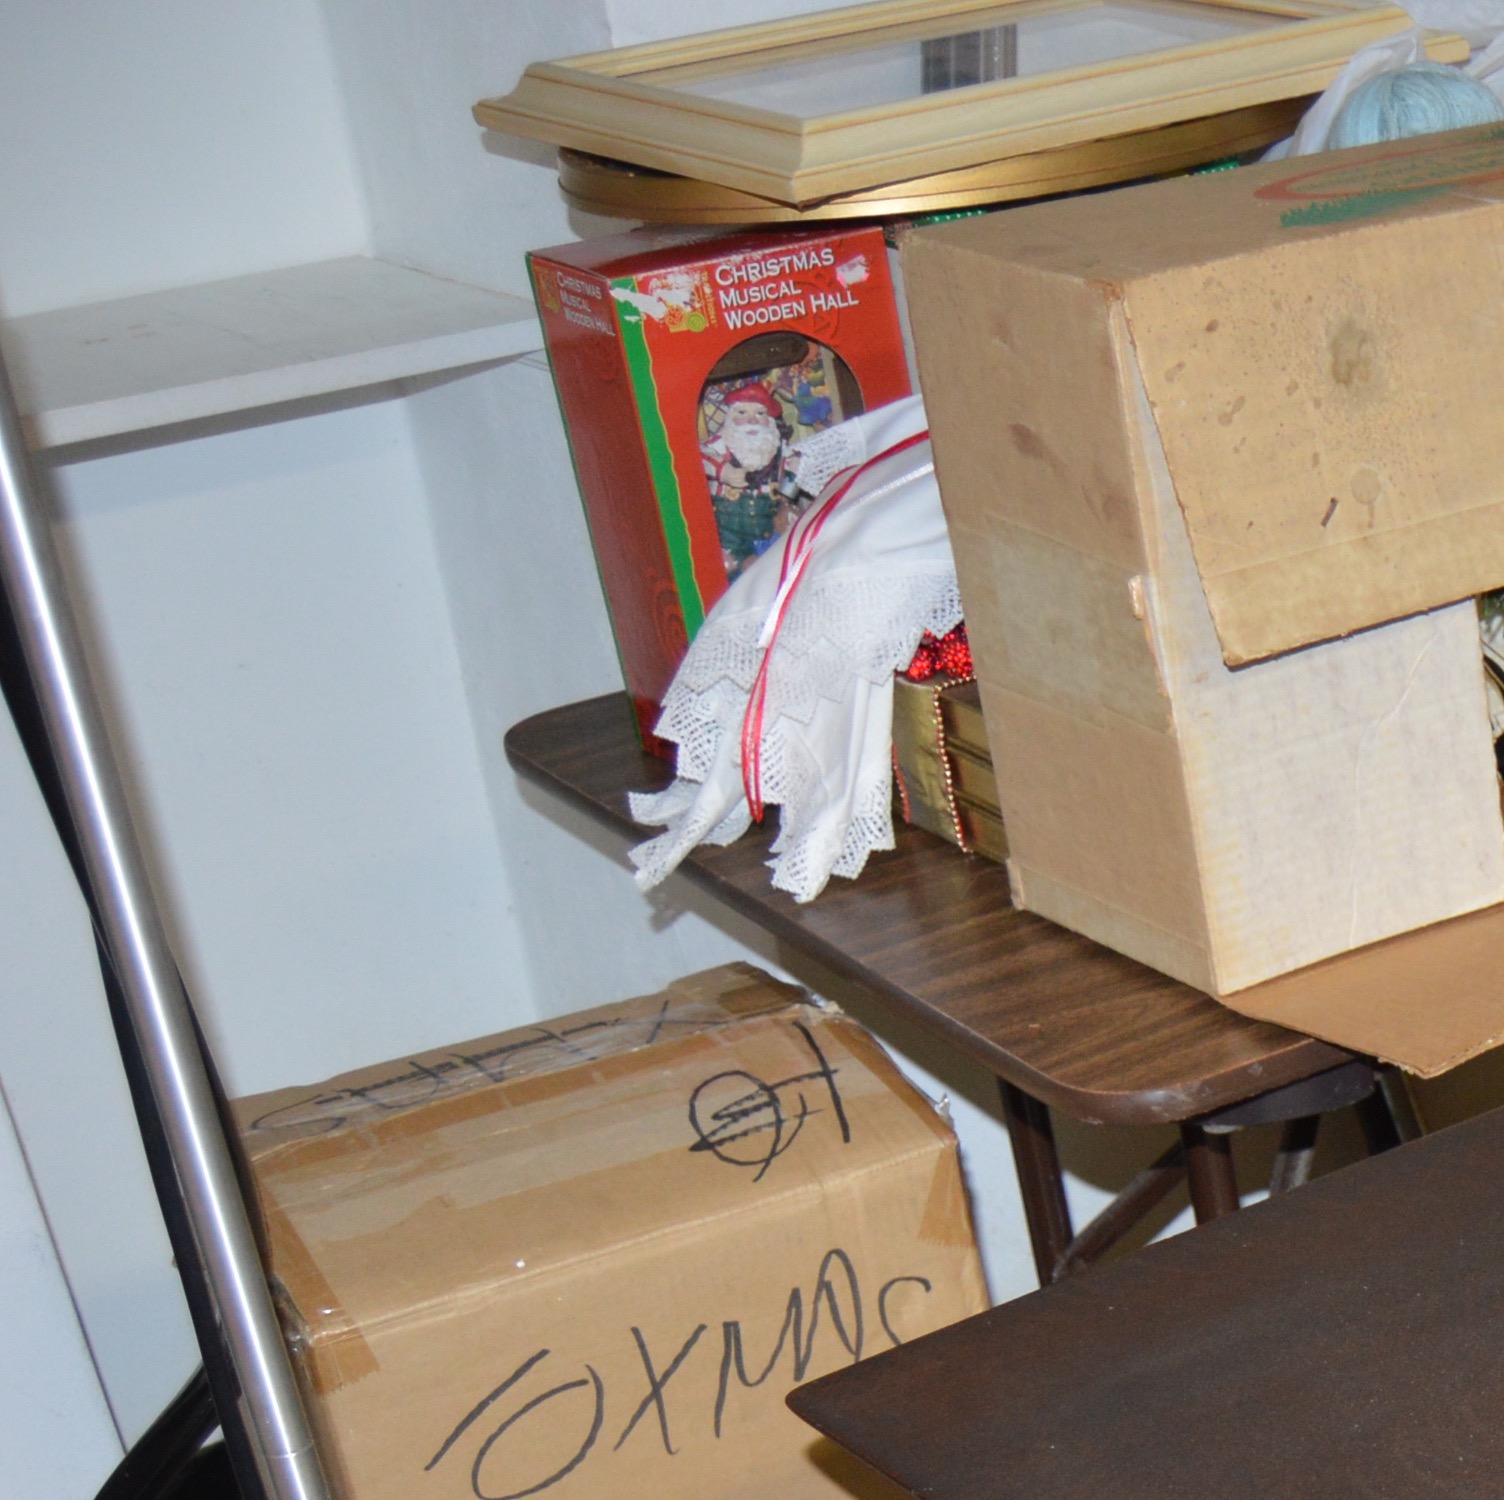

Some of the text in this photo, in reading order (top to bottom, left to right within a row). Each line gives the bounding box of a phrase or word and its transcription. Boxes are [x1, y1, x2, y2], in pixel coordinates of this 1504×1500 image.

[716, 248, 835, 286] CHRISTMAS
[556, 271, 602, 300] CHRISTMAS
[719, 280, 802, 308] MUSICAL
[560, 290, 591, 312] MUSICAL
[724, 291, 859, 331] WOODEN HALL
[564, 308, 595, 329] WOODEN
